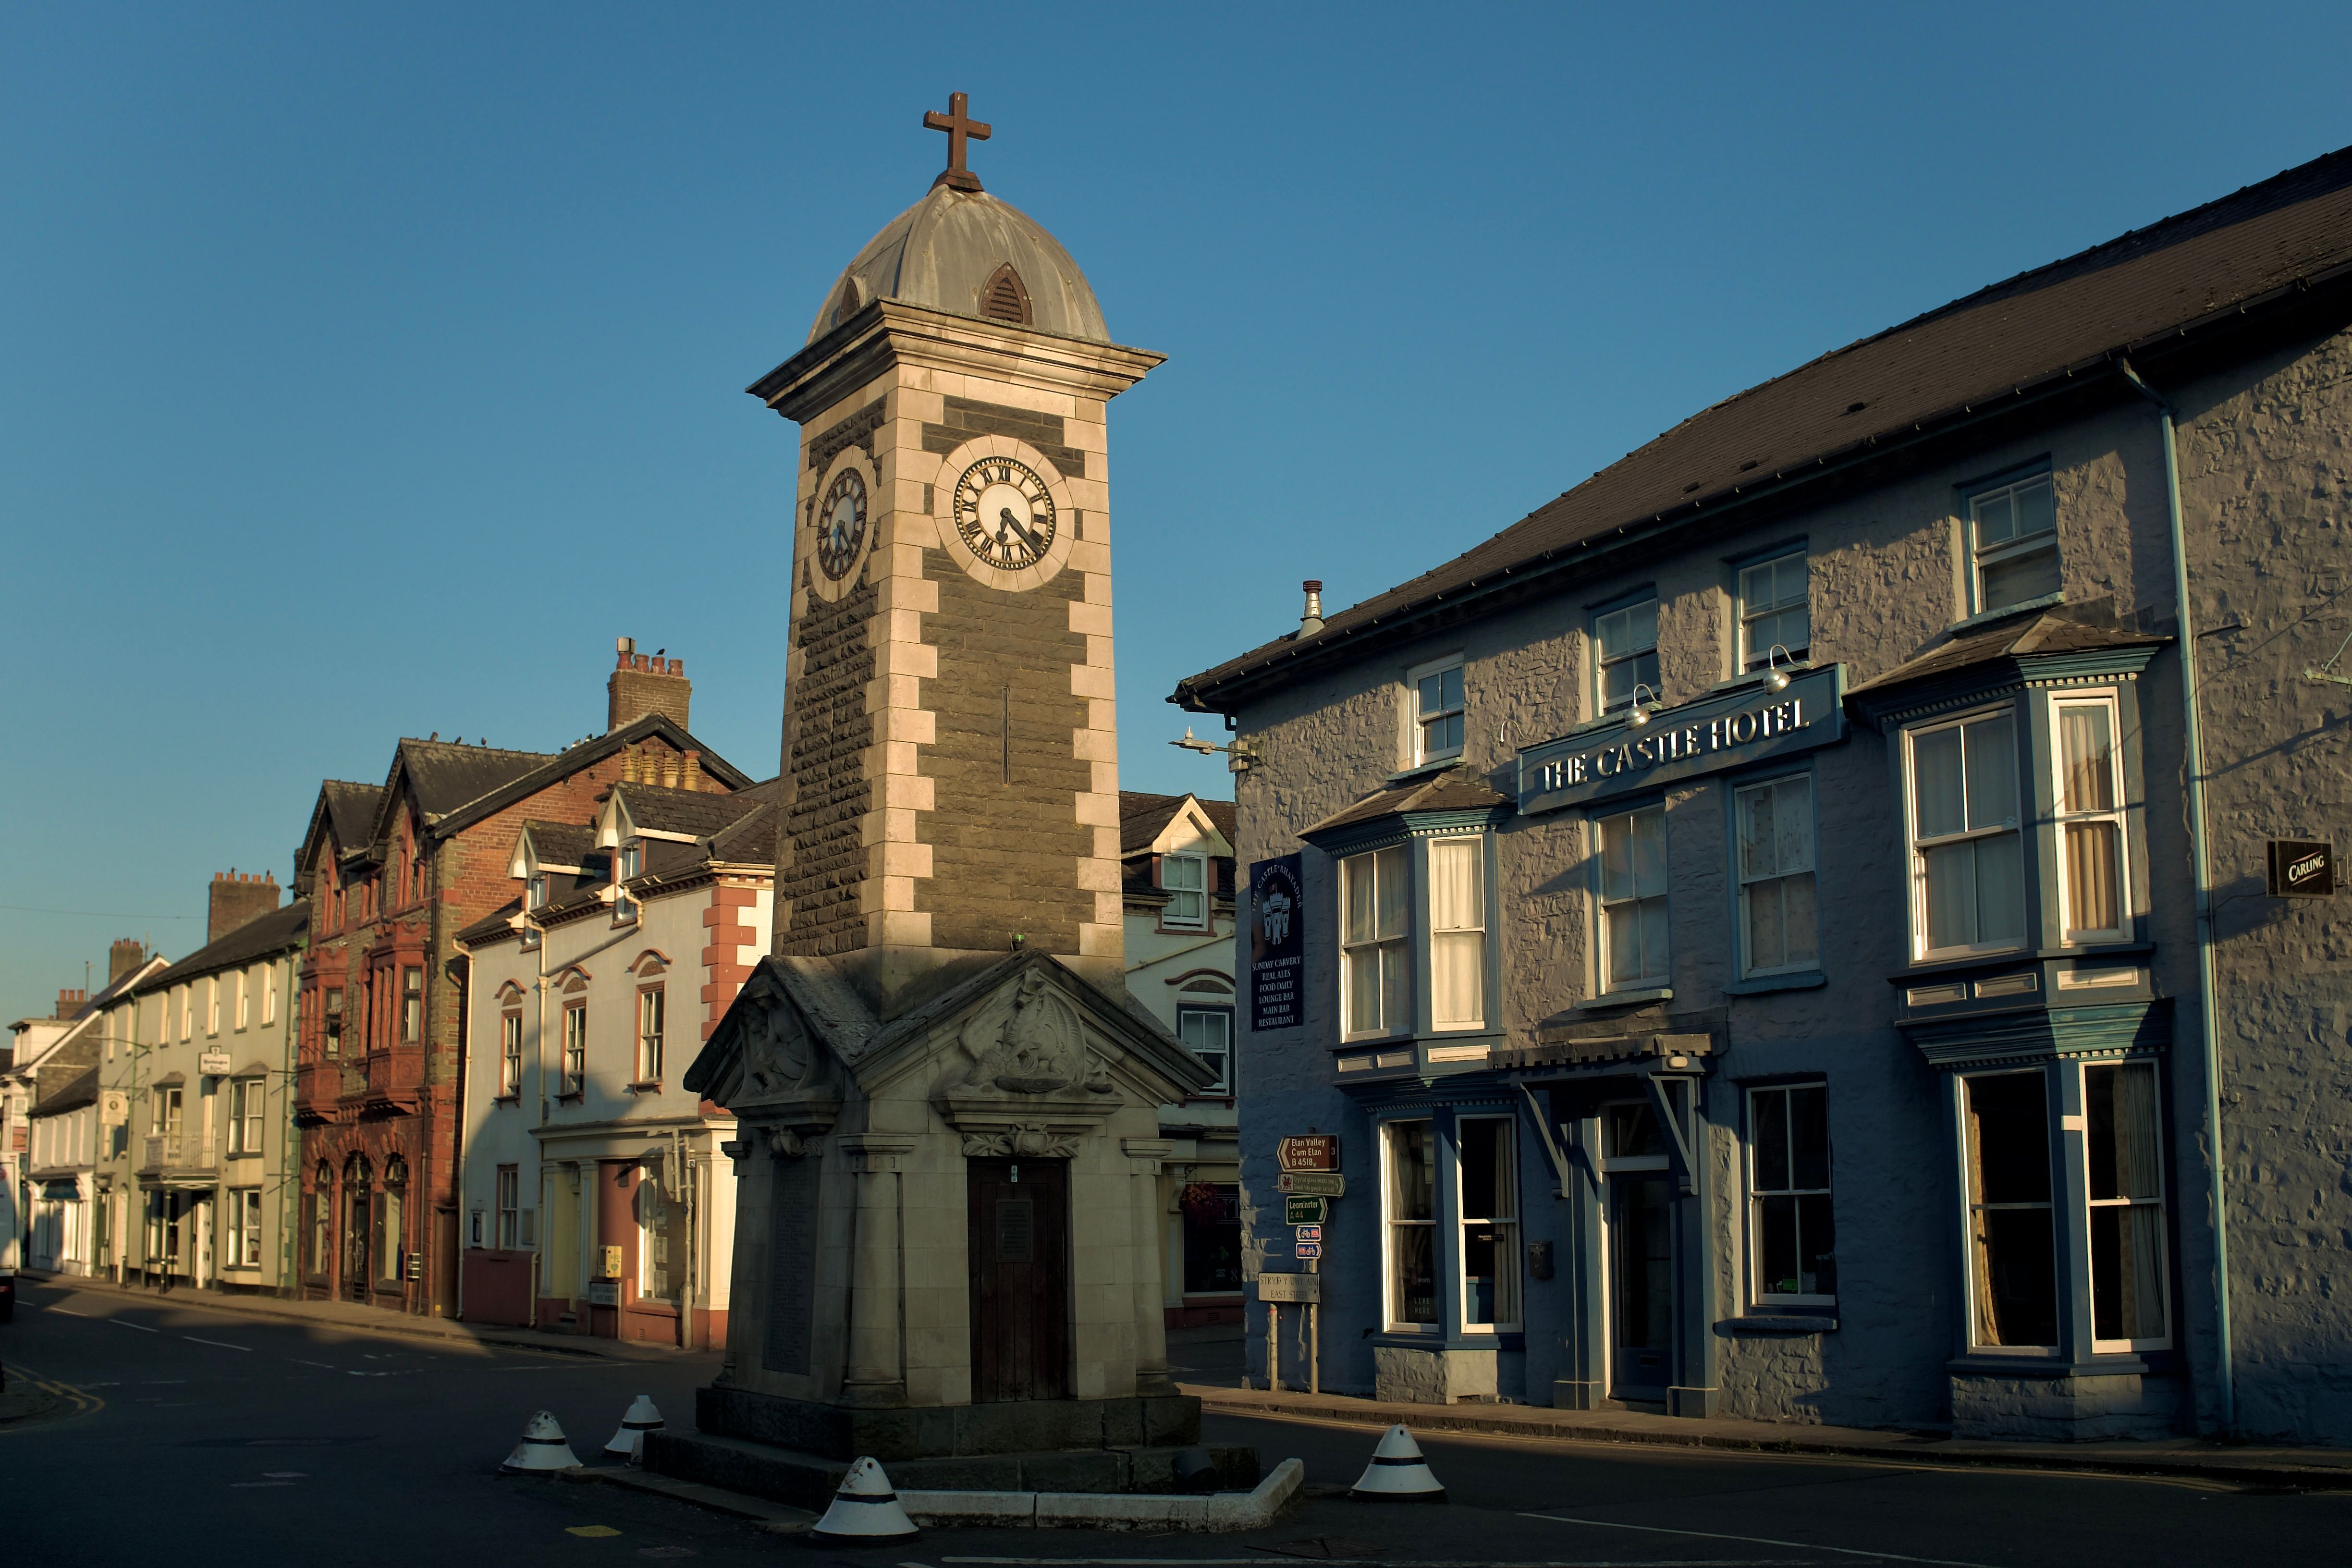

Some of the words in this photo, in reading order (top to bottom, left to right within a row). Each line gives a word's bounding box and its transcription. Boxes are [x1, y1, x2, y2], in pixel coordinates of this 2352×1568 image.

[1542, 753, 1588, 792] THE
[1596, 724, 1701, 777] CASTLE
[1711, 698, 1810, 751] HOTEL
[2289, 855, 2324, 882] CARLING
[1258, 865, 1277, 889] CASTLE
[1280, 865, 1301, 908] RHAYADER
[1252, 960, 1274, 971] SUNDAY
[1275, 956, 1301, 967] CARVERY
[1262, 971, 1276, 980] REAL
[1277, 969, 1290, 979] ALES
[1260, 983, 1275, 992] FOOD
[1277, 980, 1293, 990] DAILY
[1259, 994, 1282, 1004] LOUNGE
[1283, 992, 1294, 1001] BAR
[1263, 1006, 1278, 1015] MAIN
[1279, 1004, 1290, 1013] BAR
[1259, 1015, 1294, 1027] RESTAURANT
[1306, 1138, 1325, 1147] Valley
[1289, 1201, 1318, 1209] Leominster
[1295, 1211, 1303, 1219] 44
[1260, 1276, 1281, 1285] STRYD
[1283, 1276, 1287, 1285] Y
[1271, 1290, 1286, 1298] EAST
[1289, 1291, 1307, 1299] STREET
